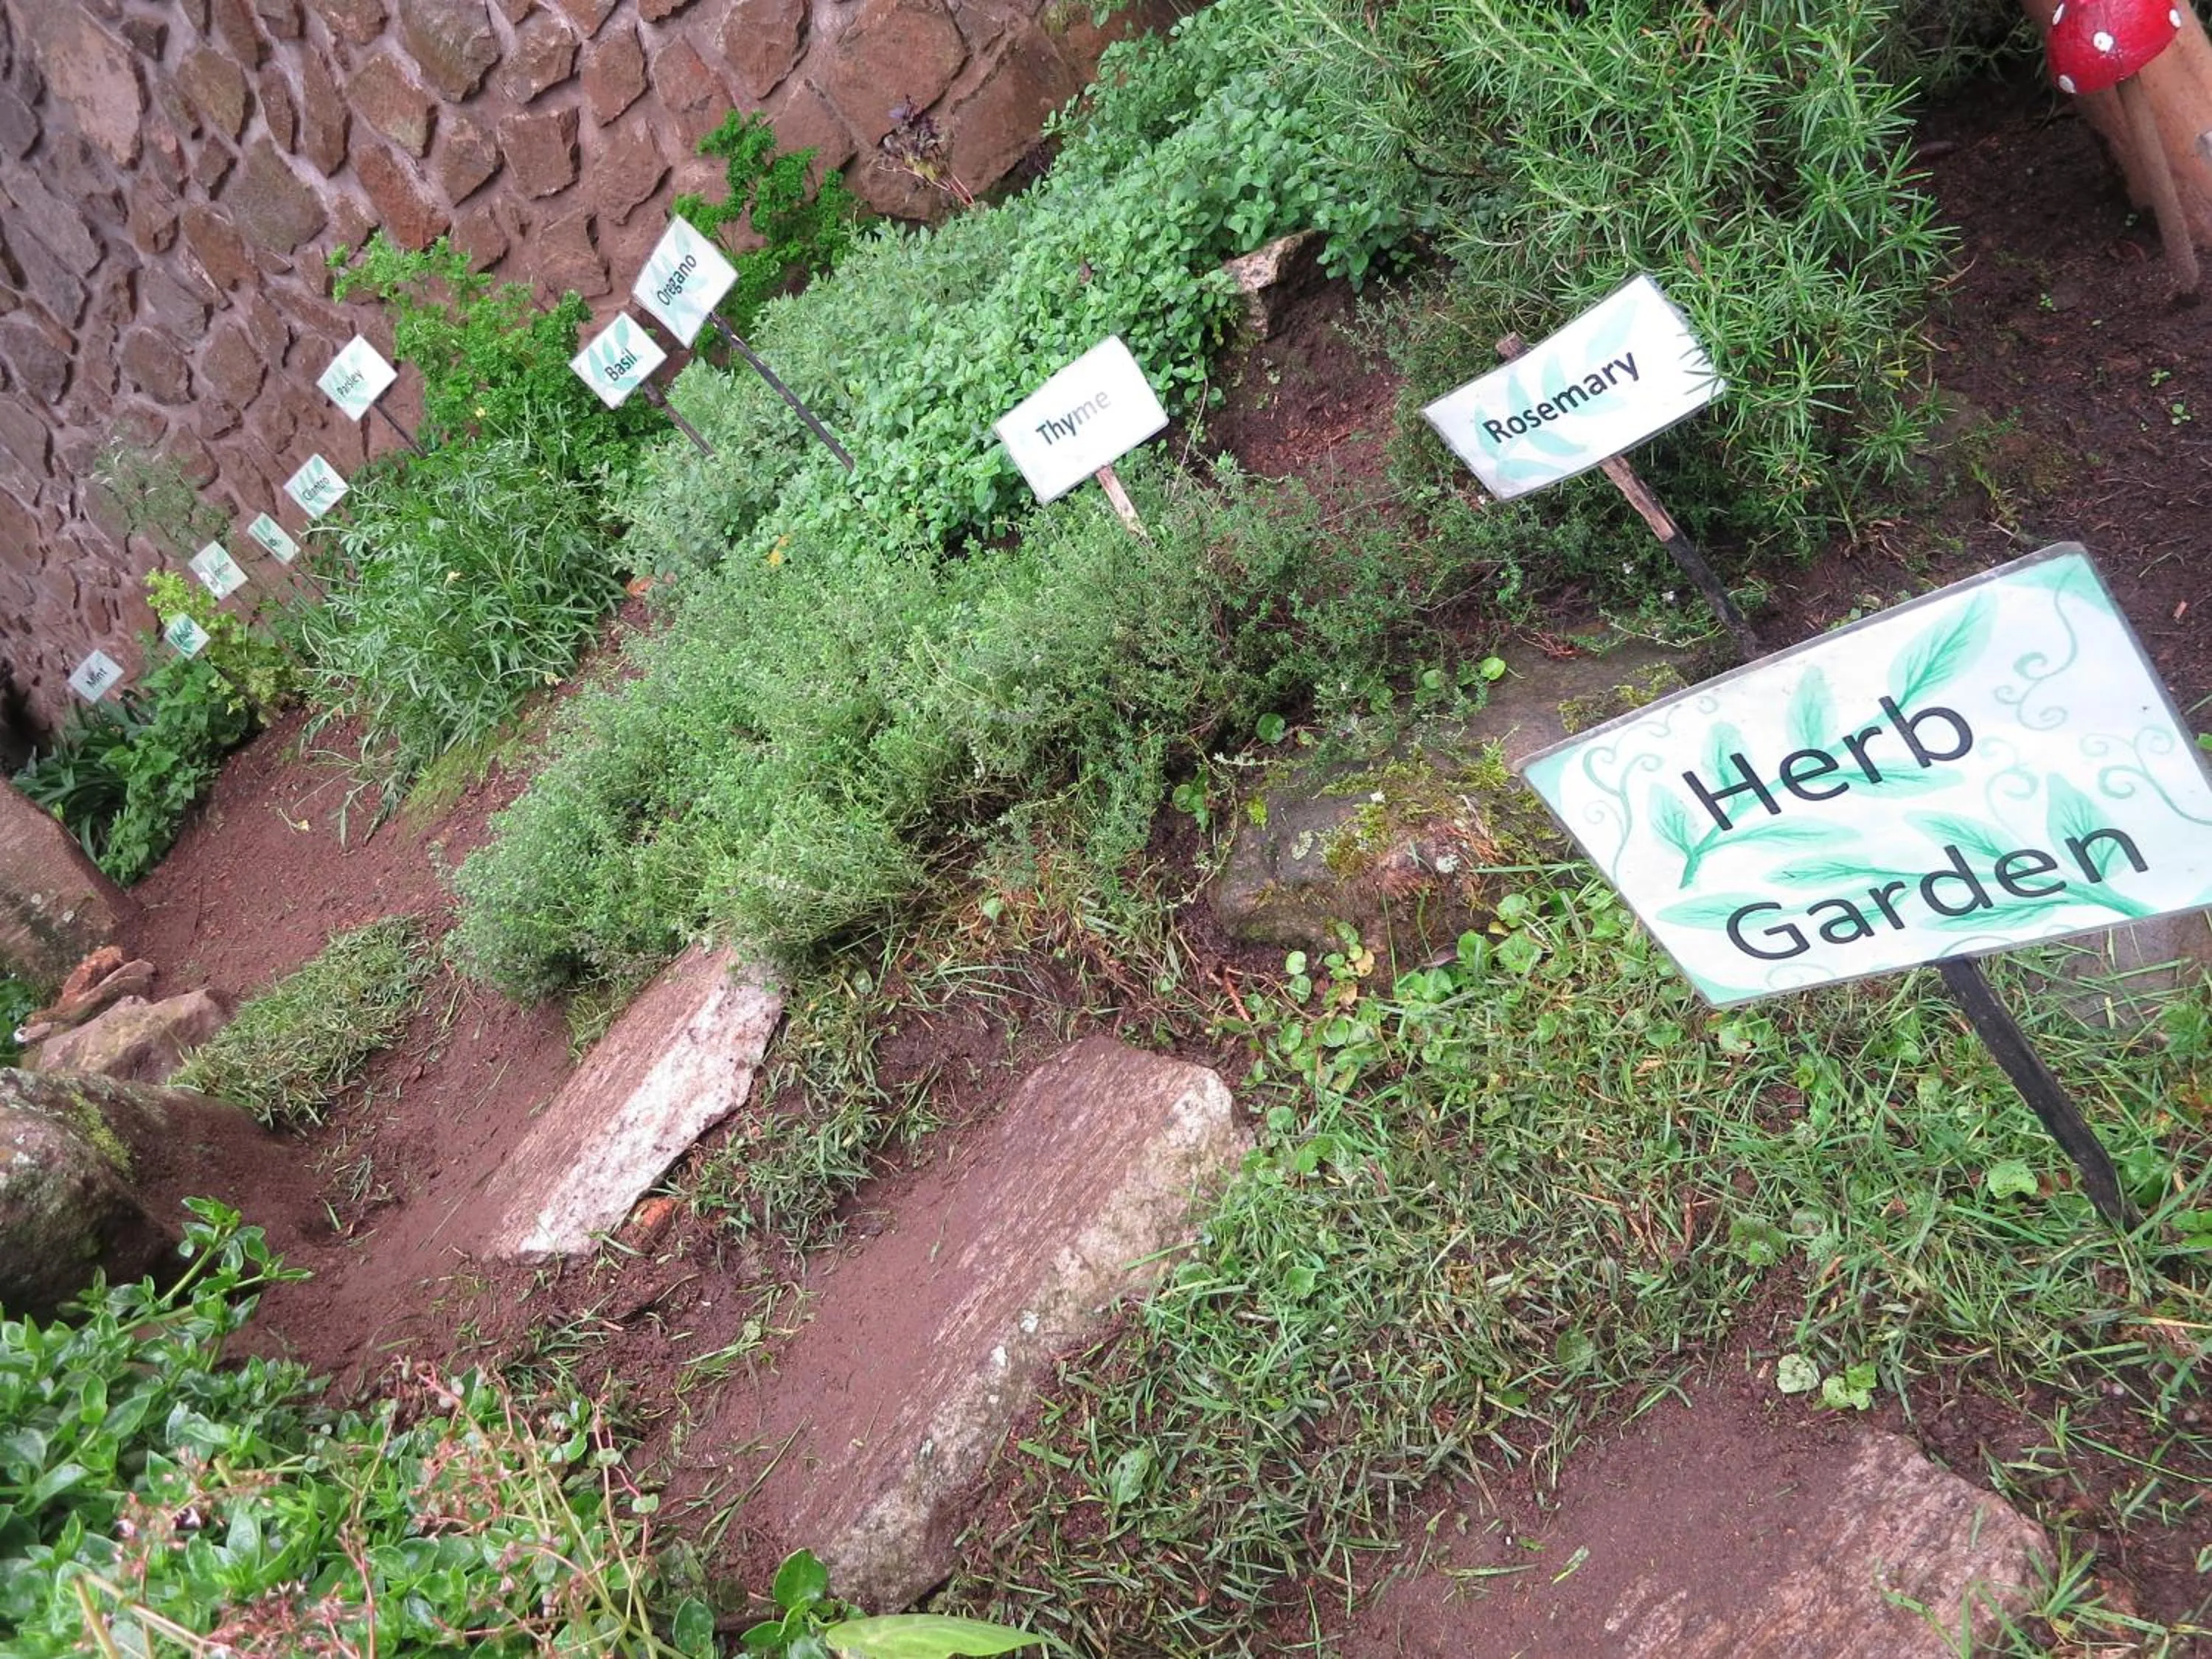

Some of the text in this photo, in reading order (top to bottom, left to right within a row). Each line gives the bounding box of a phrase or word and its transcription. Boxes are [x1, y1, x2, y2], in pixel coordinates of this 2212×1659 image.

[657, 254, 697, 306] Oregano
[336, 368, 365, 398] Parsley
[604, 347, 638, 381] Basil
[1035, 392, 1111, 445] Thyme
[1482, 352, 1640, 443] Rosemary
[1683, 695, 1974, 831] Herb
[1726, 828, 2149, 959] Garden
